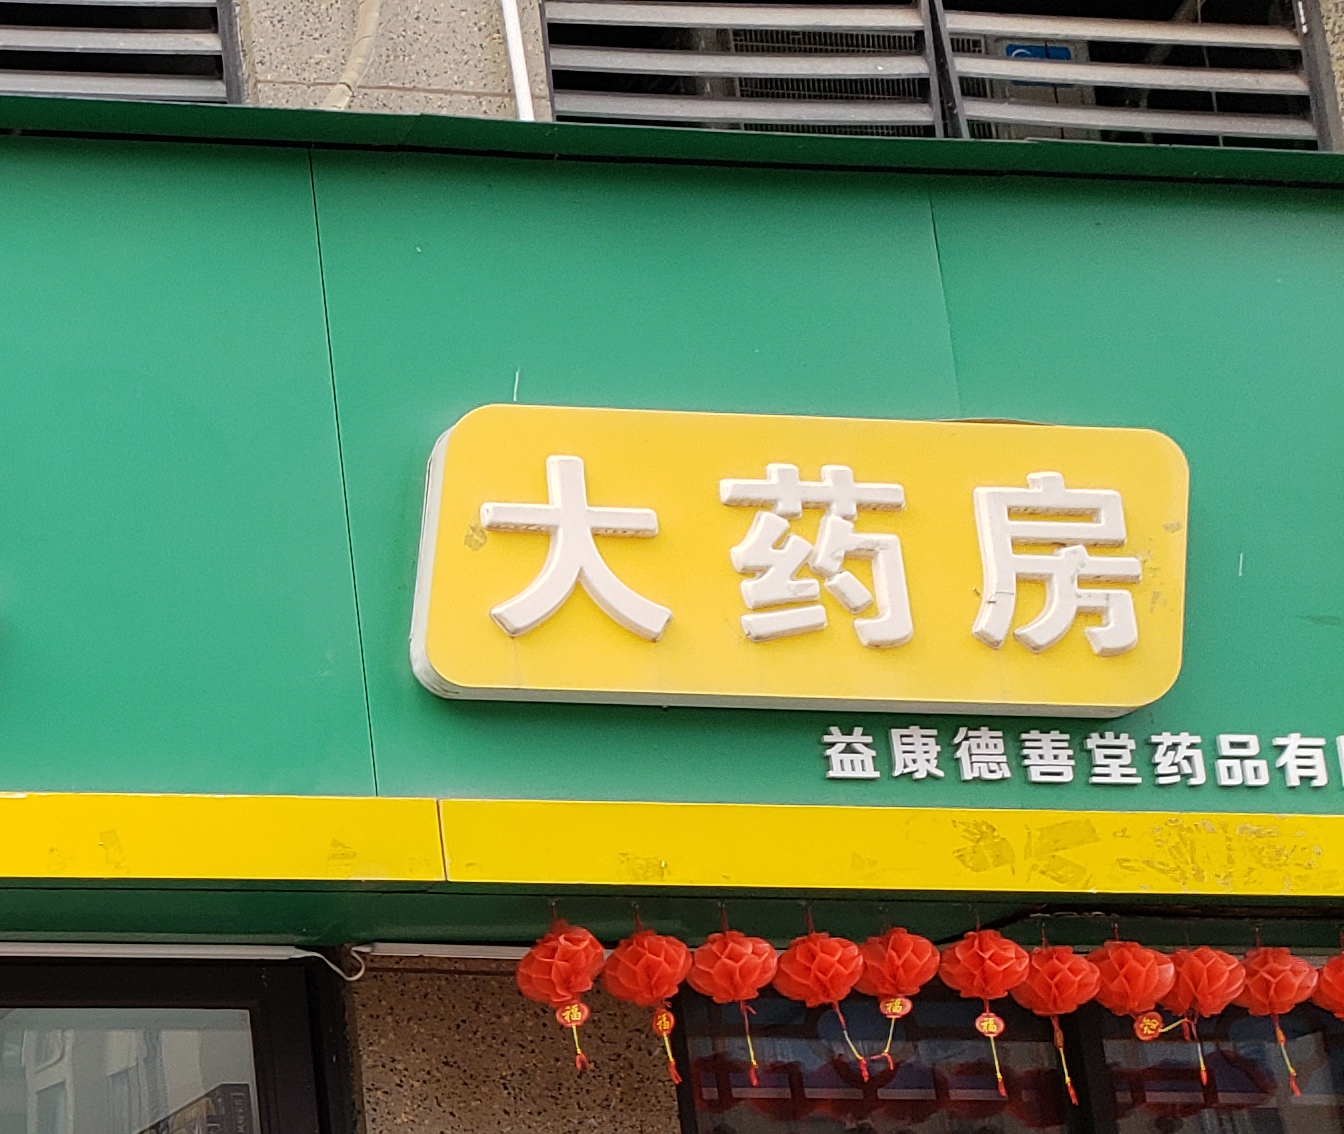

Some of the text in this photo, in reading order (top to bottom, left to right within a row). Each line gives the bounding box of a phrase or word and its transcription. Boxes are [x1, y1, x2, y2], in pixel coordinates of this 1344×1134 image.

[480, 454, 1144, 657] 大药房
[821, 725, 1344, 789] 益康德善堂药品有
